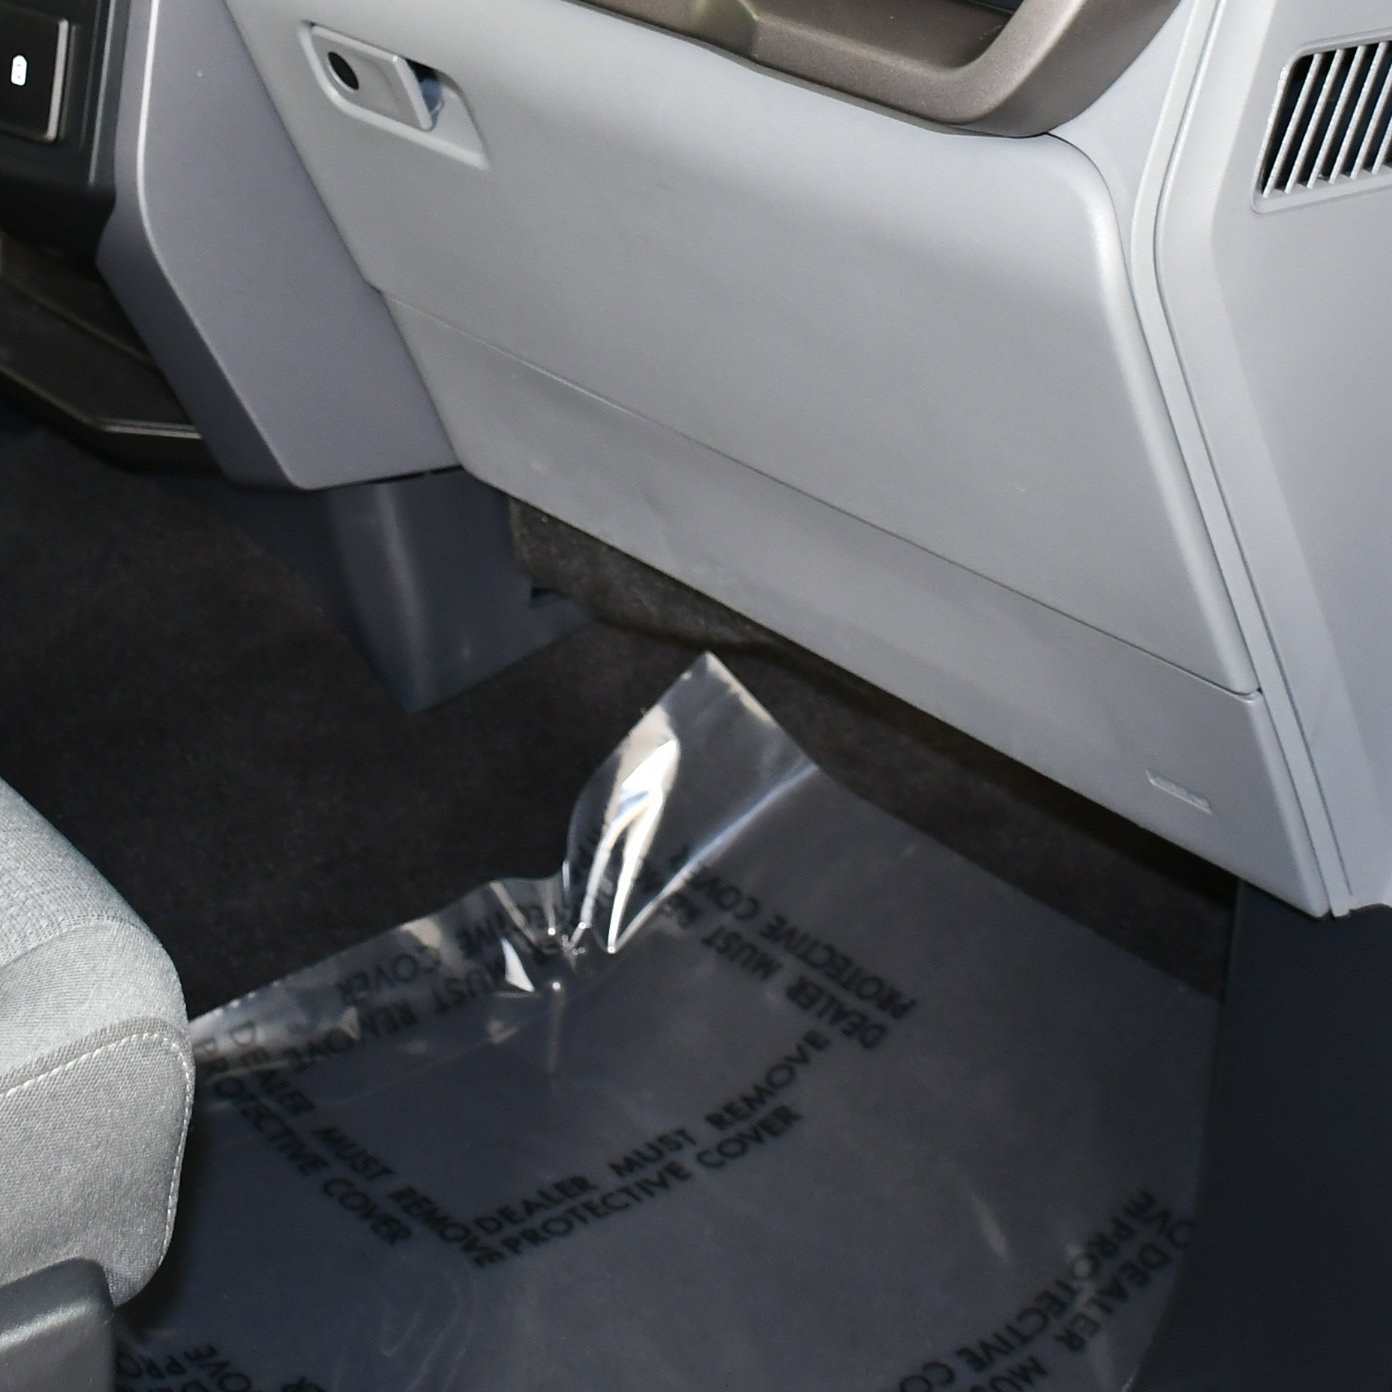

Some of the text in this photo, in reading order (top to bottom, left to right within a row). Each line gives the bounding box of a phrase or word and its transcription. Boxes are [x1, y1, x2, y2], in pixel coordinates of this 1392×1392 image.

[700, 924, 894, 1053] DEALER MUST
[757, 913, 921, 1021] PROTECTIVE
[311, 1123, 396, 1182] MUST
[388, 1183, 508, 1270] REMOVE
[473, 1028, 833, 1236] DEALER MUST REMOVE
[501, 1103, 804, 1256] PROTECTIVE COVER
[321, 1175, 414, 1247] COVER
[955, 1216, 1137, 1373] PROTECTIVE
[1053, 1242, 1170, 1353] DEALER
